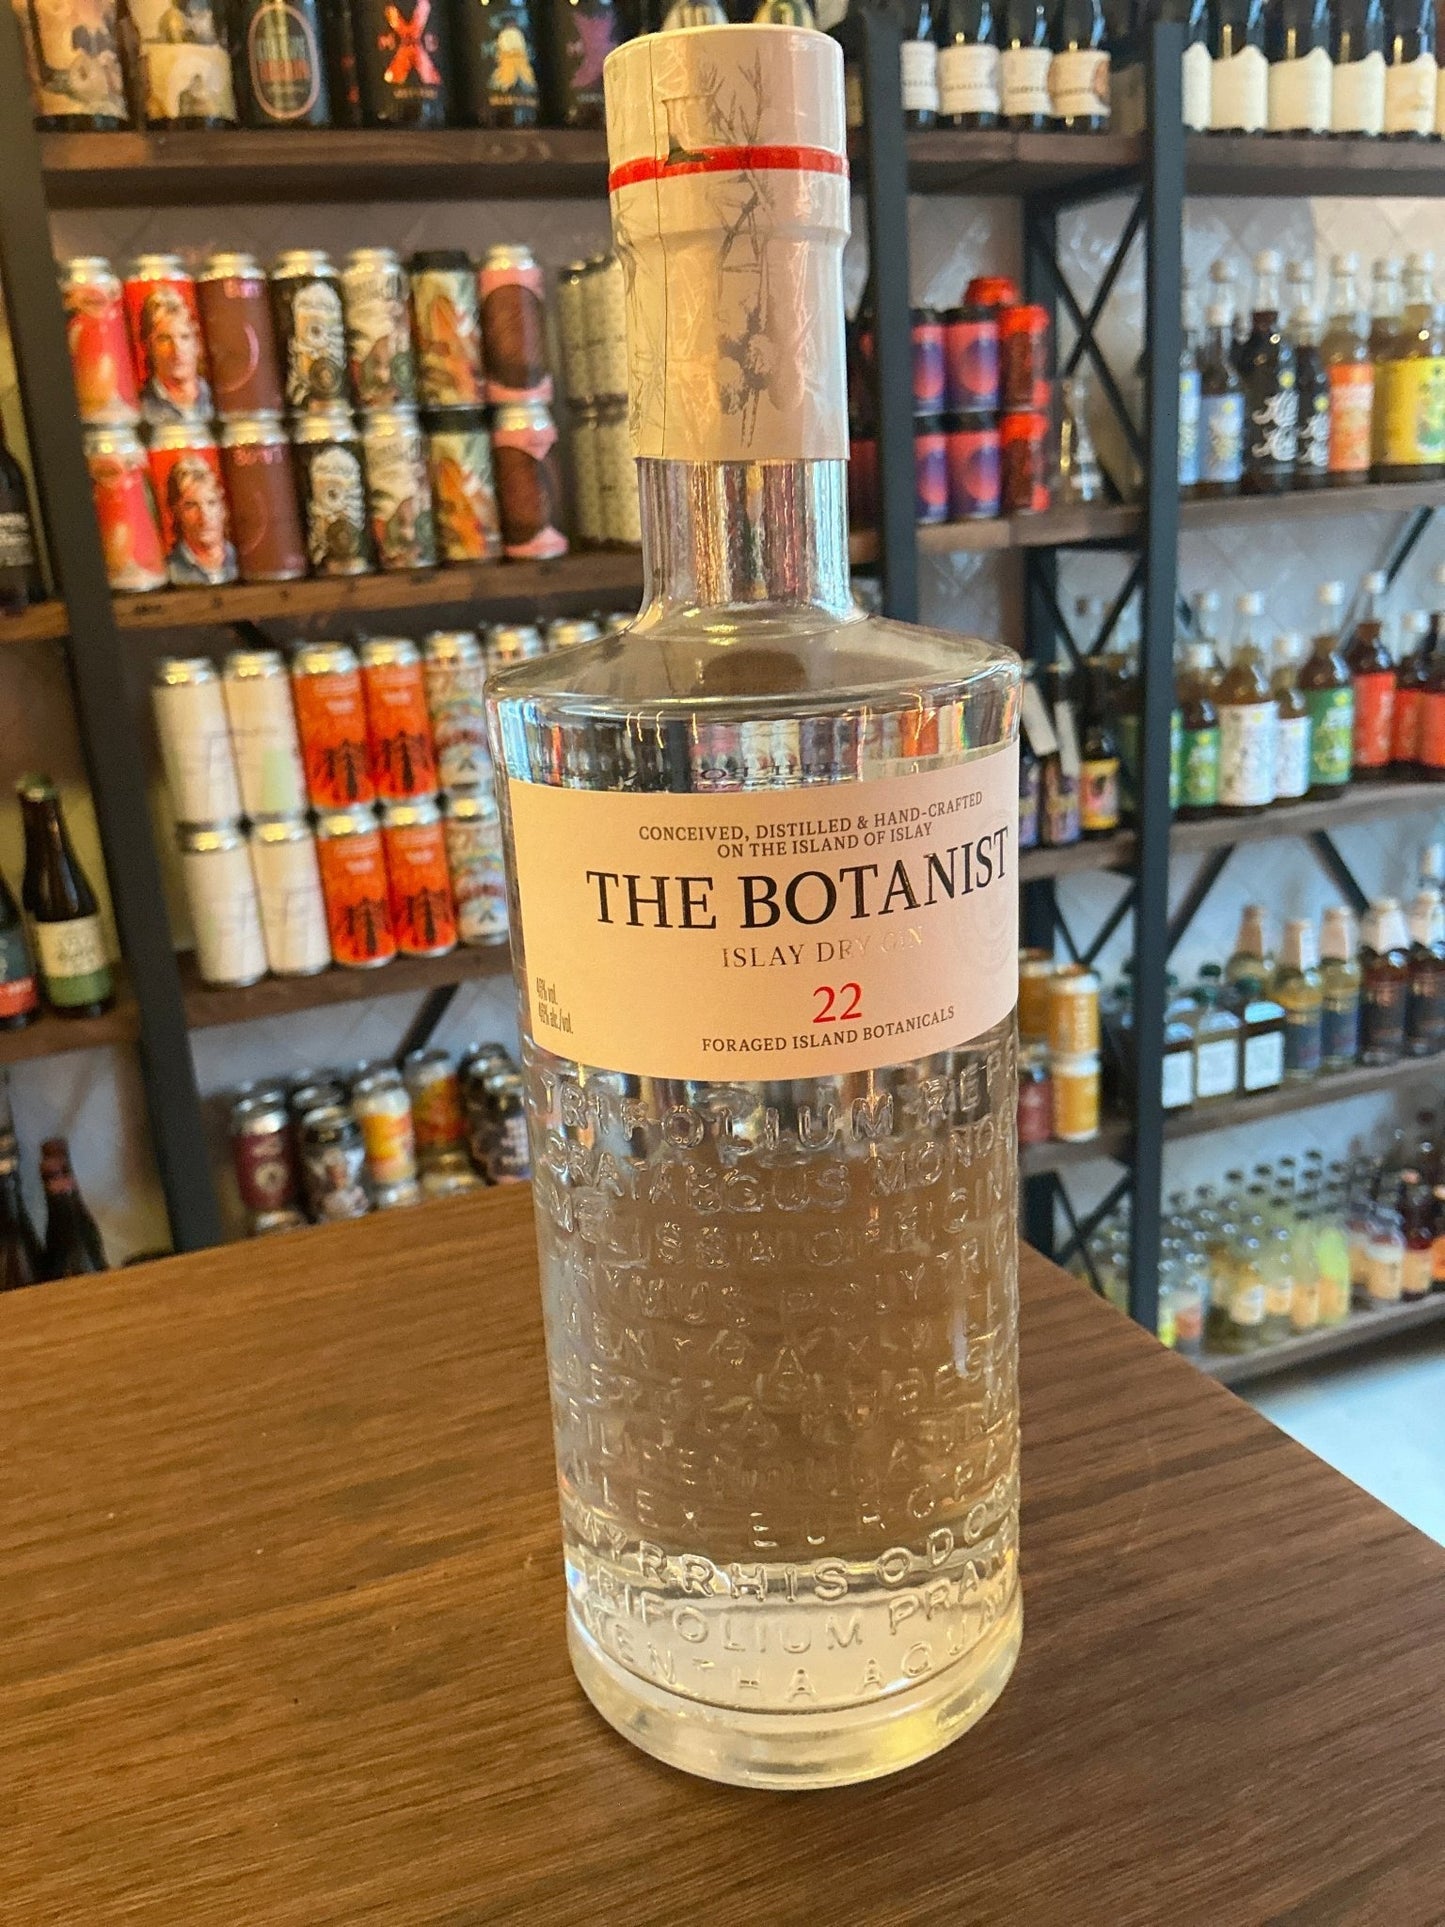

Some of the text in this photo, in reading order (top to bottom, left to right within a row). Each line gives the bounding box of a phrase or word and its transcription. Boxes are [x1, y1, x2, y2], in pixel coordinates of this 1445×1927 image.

[638, 790, 984, 844] CONCEIVED, DISTILLED & HAND-CRAFTED
[716, 821, 934, 858] ON THE ISLAND OF ISLAY
[586, 869, 718, 930] THE
[737, 825, 1010, 929] BOTANIST
[722, 943, 806, 968] ISLAY
[816, 934, 870, 964] DRY
[811, 981, 864, 1025] 22
[701, 1004, 956, 1053] FORAGED ISLAND BOTANICALS
